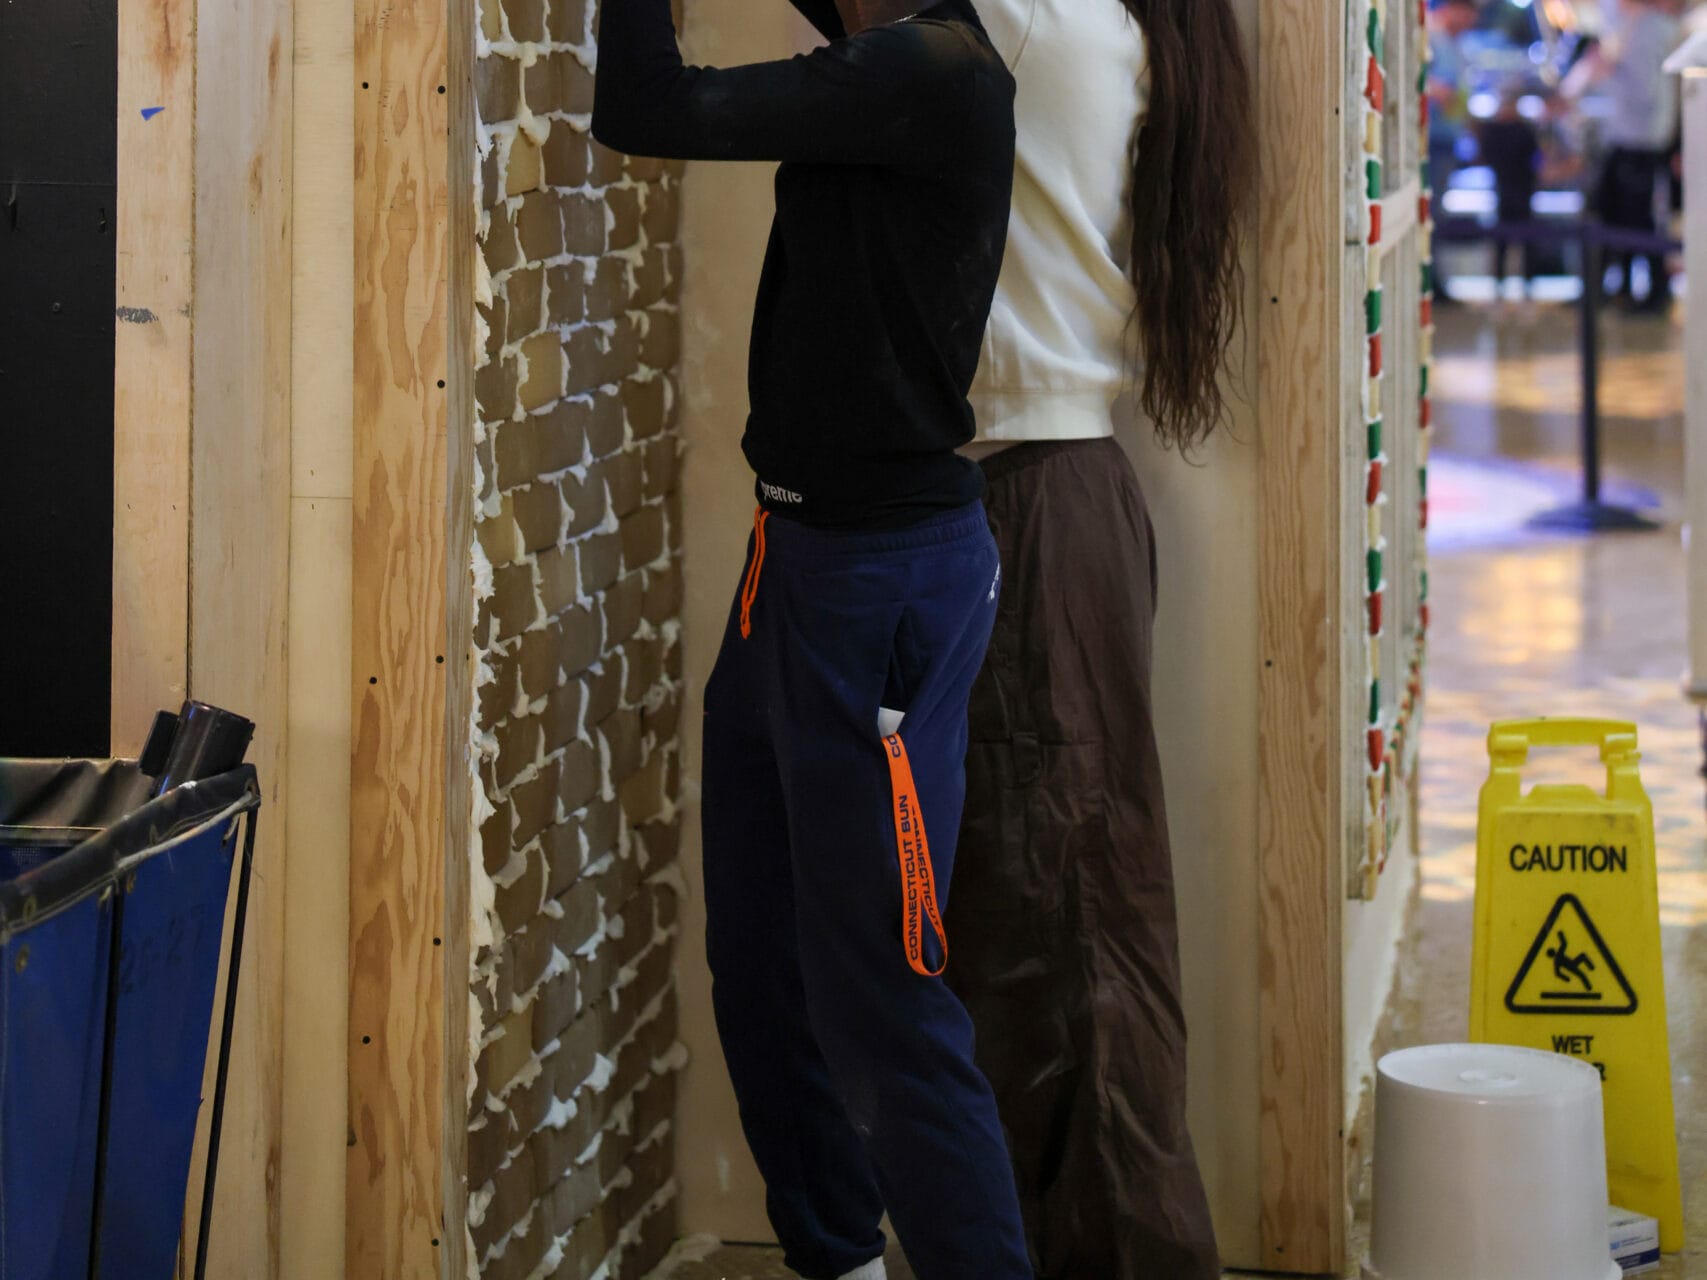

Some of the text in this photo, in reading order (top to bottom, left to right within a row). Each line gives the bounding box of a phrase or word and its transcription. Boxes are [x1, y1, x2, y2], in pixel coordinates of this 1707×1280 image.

[1509, 844, 1628, 873] CAUTION
[903, 840, 919, 961] CONNECTICUT
[1551, 1034, 1594, 1055] WET
